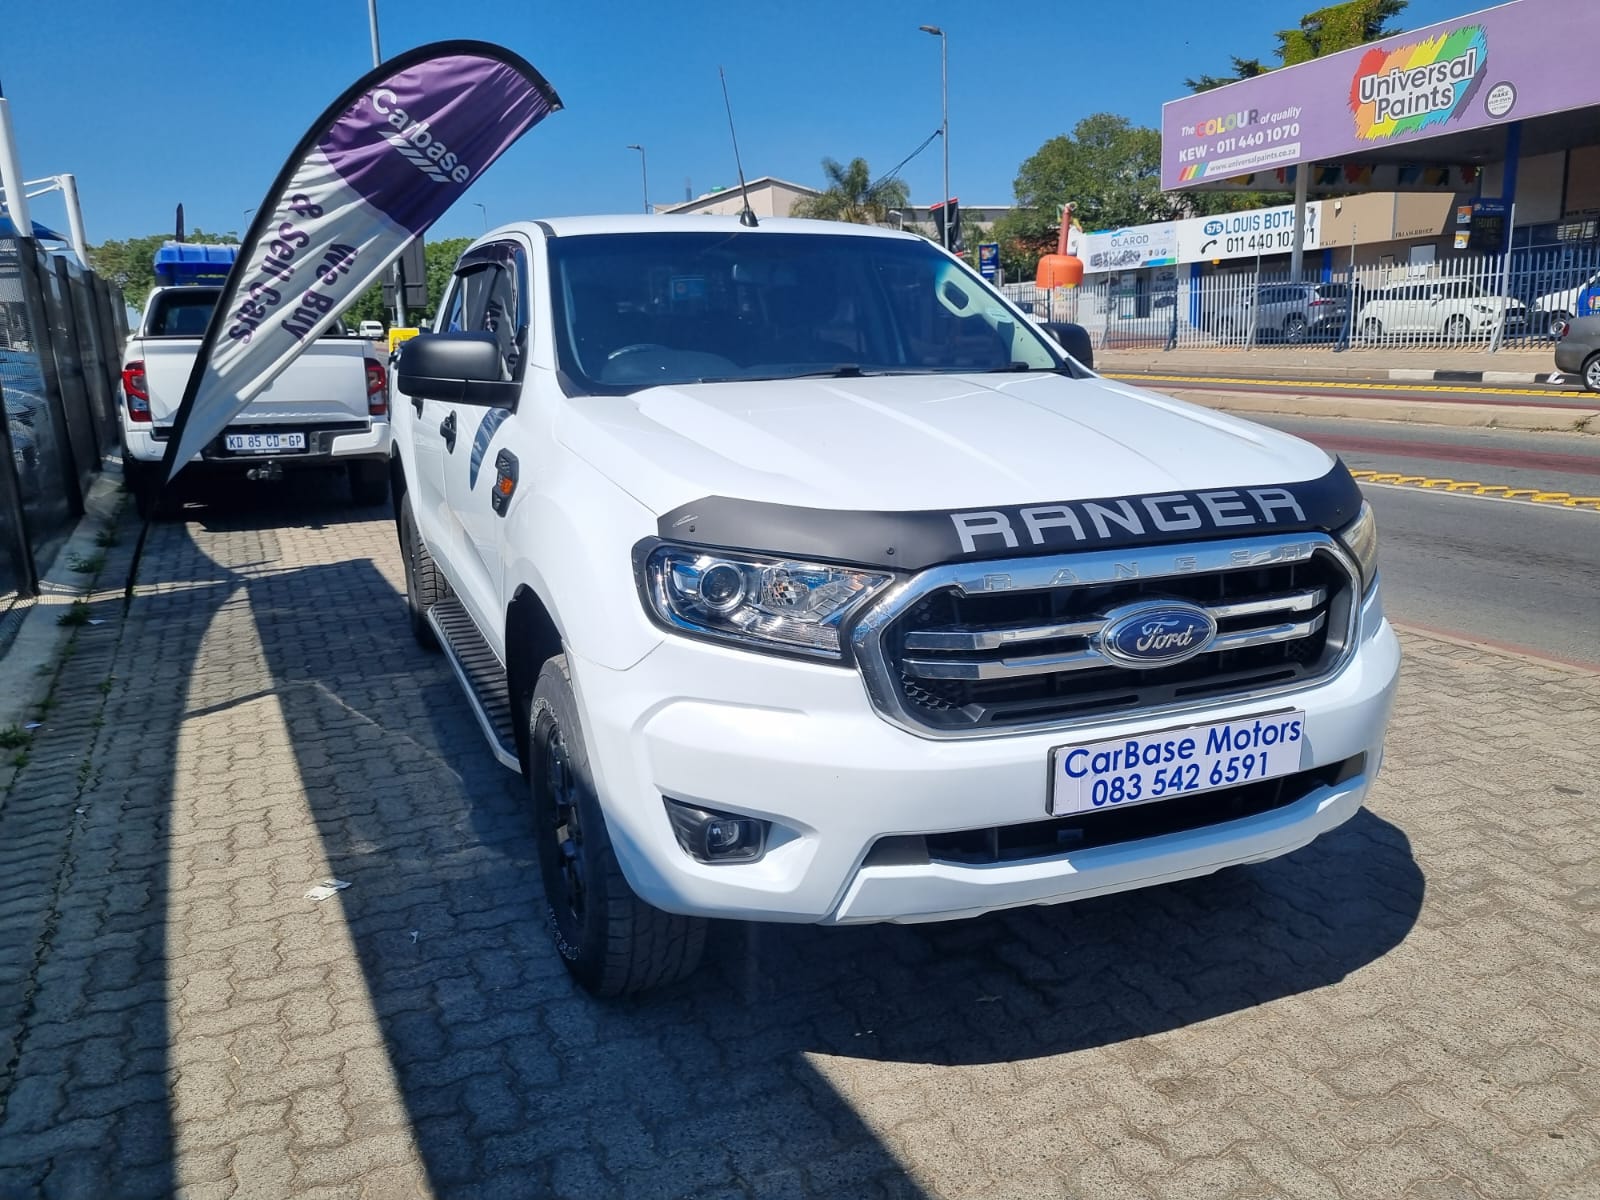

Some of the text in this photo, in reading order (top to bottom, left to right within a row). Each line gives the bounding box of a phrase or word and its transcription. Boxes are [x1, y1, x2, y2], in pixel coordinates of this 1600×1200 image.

[1360, 50, 1476, 101] Universal
[1181, 106, 1302, 138] The COLOUR of quality
[1376, 85, 1453, 121] Paints
[372, 88, 470, 184] Carbase
[1179, 145, 1208, 162] KEW
[1216, 138, 1236, 153] 011
[1238, 131, 1264, 148] 440
[1266, 123, 1300, 142] 1070
[1210, 148, 1297, 171] www.universalpaints.co.za
[1110, 235, 1149, 247] OLAROD
[1206, 222, 1221, 233] 575
[1225, 215, 1260, 234] LOUIS
[1226, 236, 1244, 253] 011
[1248, 233, 1273, 250] 440
[229, 193, 323, 344] & Sell Cars
[281, 243, 360, 344] We Buy
[228, 435, 302, 449] KD 85 CD GP
[950, 488, 1307, 554] RANGER
[983, 543, 1303, 591] RANGER
[1136, 618, 1194, 652] Ford
[1064, 720, 1302, 779] CarBase Motors
[1091, 751, 1268, 807] 083 542 6591
